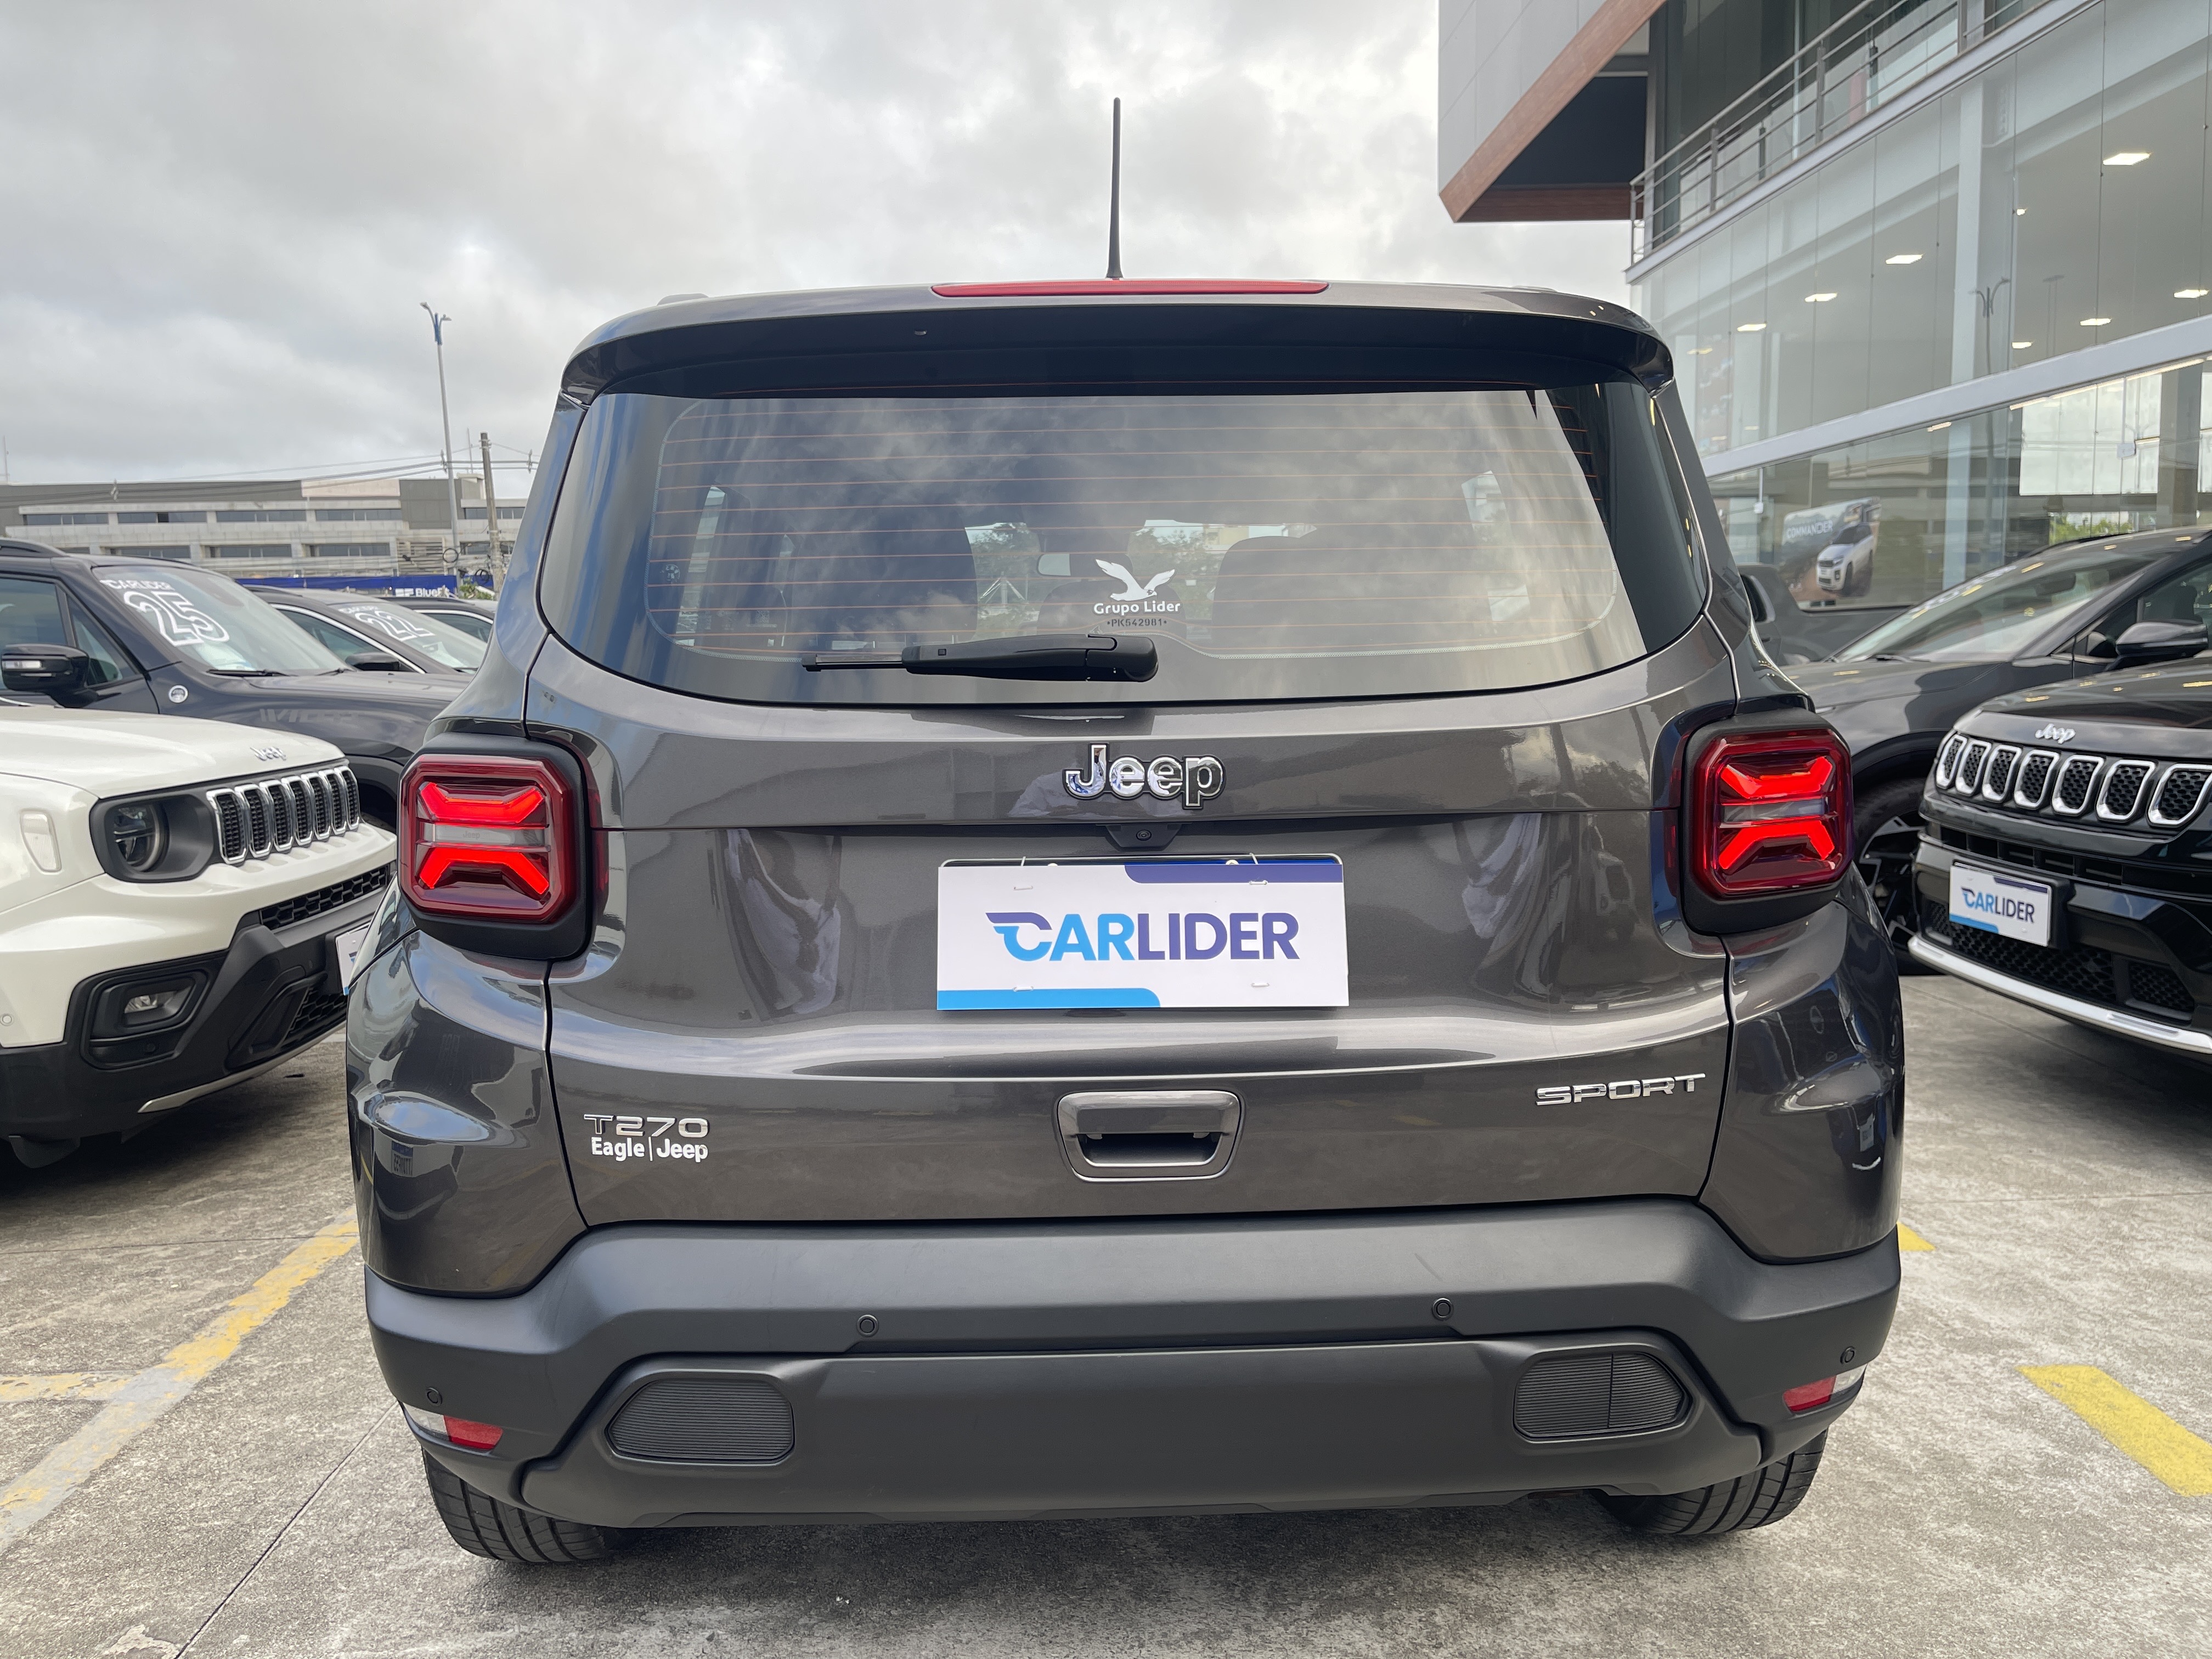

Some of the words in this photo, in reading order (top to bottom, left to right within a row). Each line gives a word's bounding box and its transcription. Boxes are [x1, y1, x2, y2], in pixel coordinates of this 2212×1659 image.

[123, 591, 229, 647] 25
[1093, 603, 1139, 616] Grupo
[1144, 601, 1180, 612] Lider
[354, 611, 436, 641] 22
[1064, 743, 1226, 809] Jeep
[1961, 887, 2034, 923] CARLIDER
[985, 912, 1300, 961] CARLIDER
[1536, 1073, 1706, 1105] SPORT
[584, 1114, 709, 1138] T270
[591, 1137, 645, 1161] Eagle
[657, 1138, 708, 1163] Jeep
